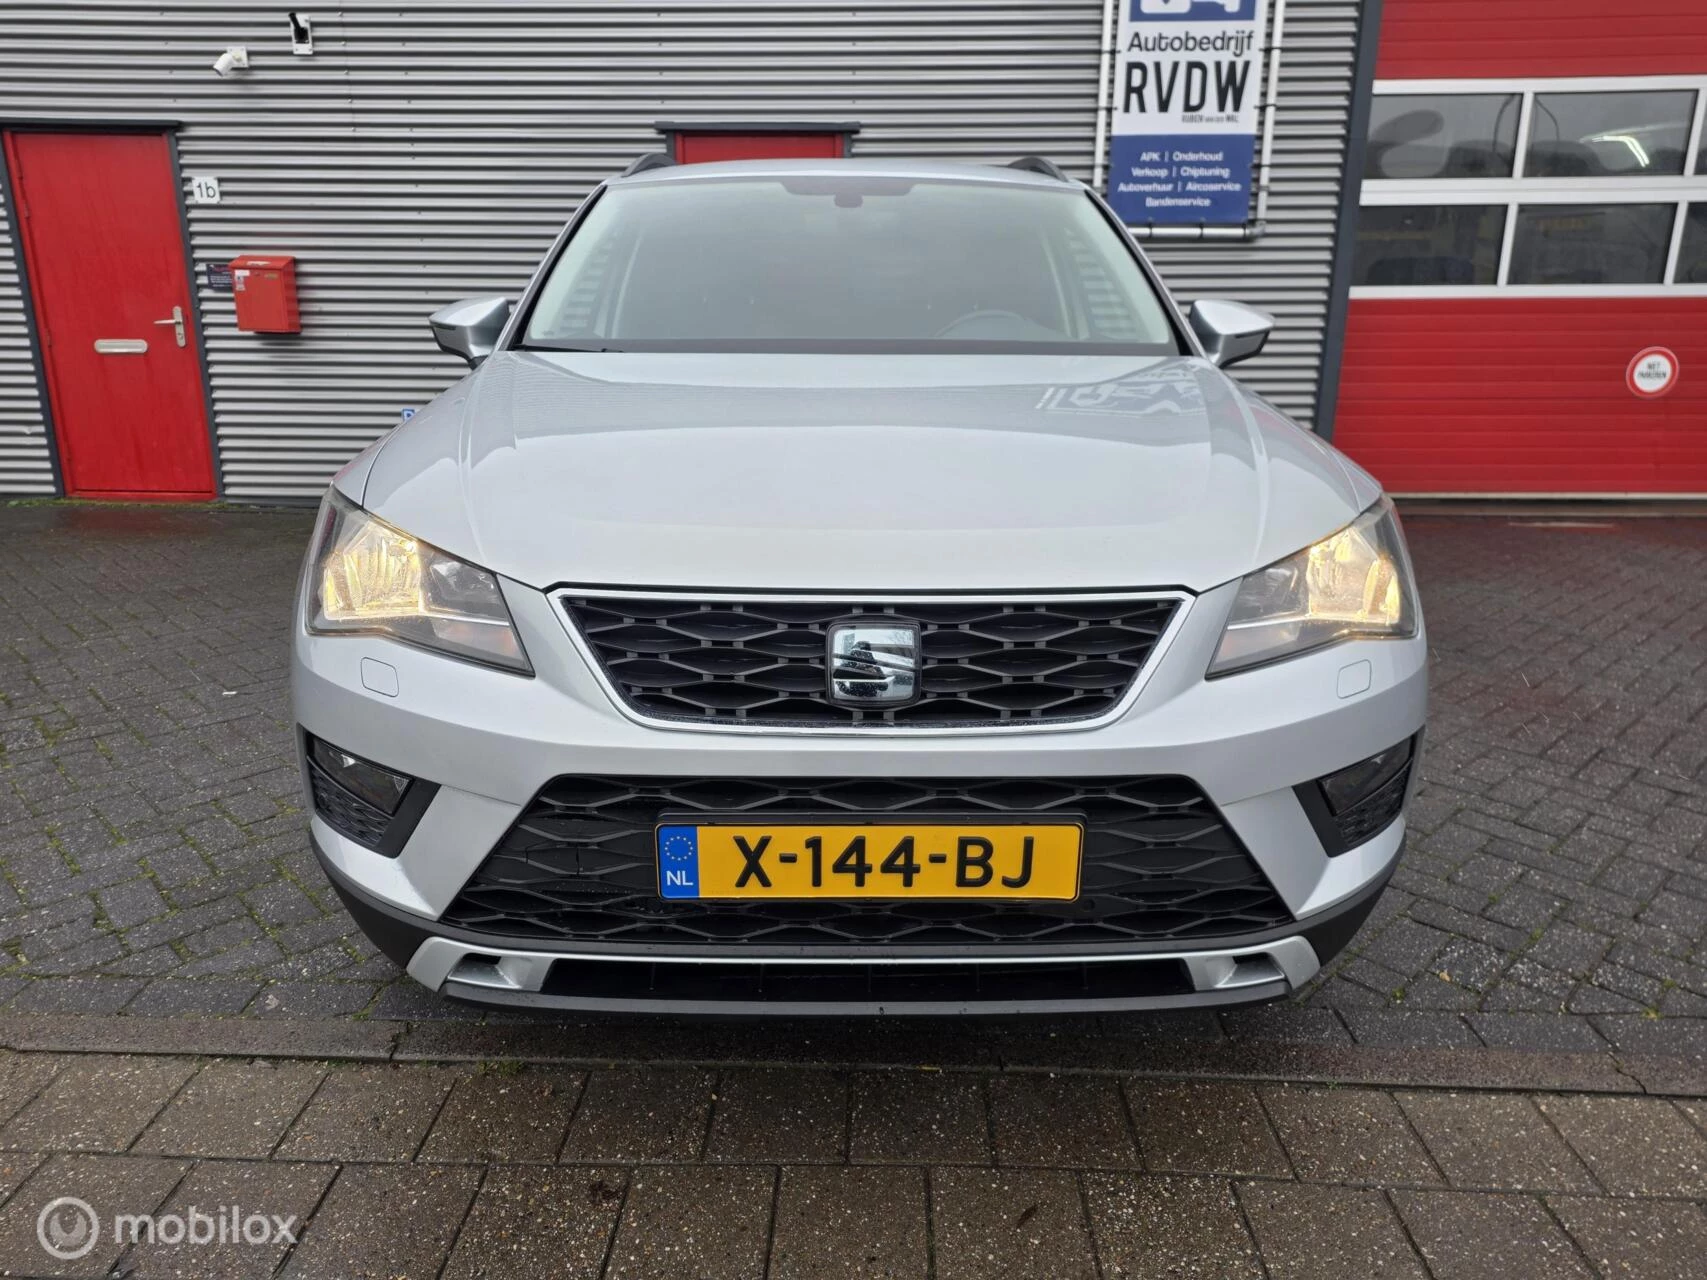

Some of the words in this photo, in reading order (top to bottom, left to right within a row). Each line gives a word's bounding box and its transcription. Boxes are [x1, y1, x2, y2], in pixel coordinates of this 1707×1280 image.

[1128, 30, 1254, 57] Autobedrijf
[1123, 60, 1250, 113] RVDW
[1140, 152, 1160, 161] APK
[1172, 151, 1224, 162] Onderhoud
[1131, 167, 1168, 178] Verkoop
[1180, 166, 1231, 178] Chiptuning
[196, 182, 216, 198] 1b
[1117, 182, 1174, 192] Autoverhuur
[1185, 181, 1242, 192] Aircoservice
[1145, 197, 1211, 207] Bandenservice
[733, 835, 1035, 888] X-144-BJ
[666, 870, 694, 886] NL
